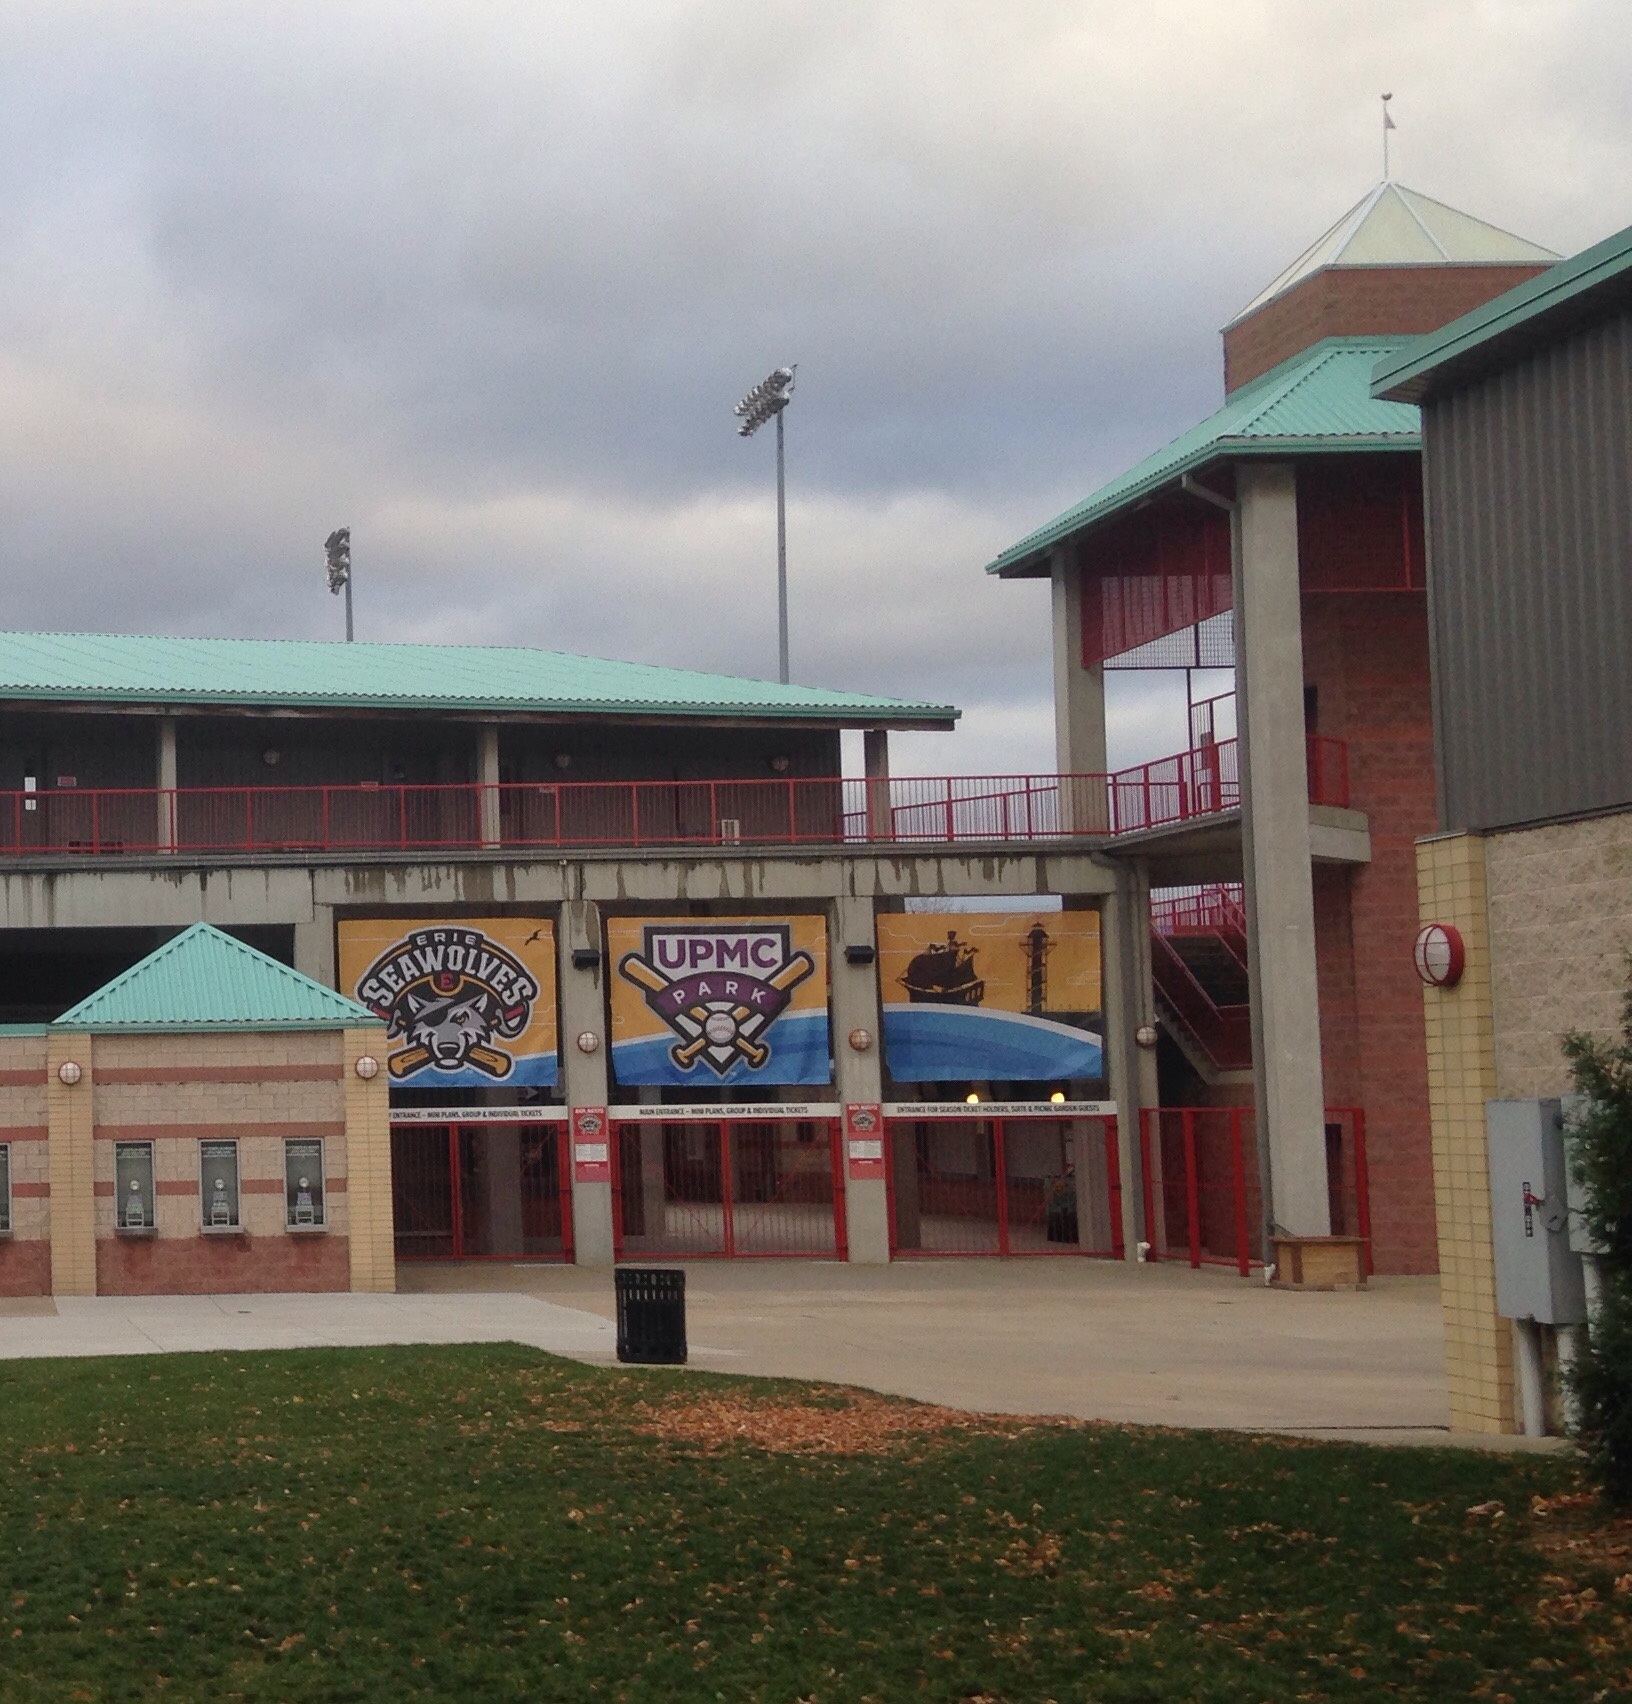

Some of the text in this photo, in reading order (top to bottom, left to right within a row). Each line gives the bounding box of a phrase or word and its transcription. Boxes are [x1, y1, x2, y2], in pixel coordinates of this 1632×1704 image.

[416, 932, 477, 945] ERIE
[657, 937, 778, 969] UPMC
[362, 945, 533, 1007] SEAWOLVES
[440, 971, 453, 989] E
[672, 980, 766, 1004] PARK
[393, 1111, 421, 1119] ENTRANCE
[520, 1109, 543, 1117] TICKETS
[785, 1106, 808, 1114] TICKETS
[963, 1105, 981, 1113] TICKET
